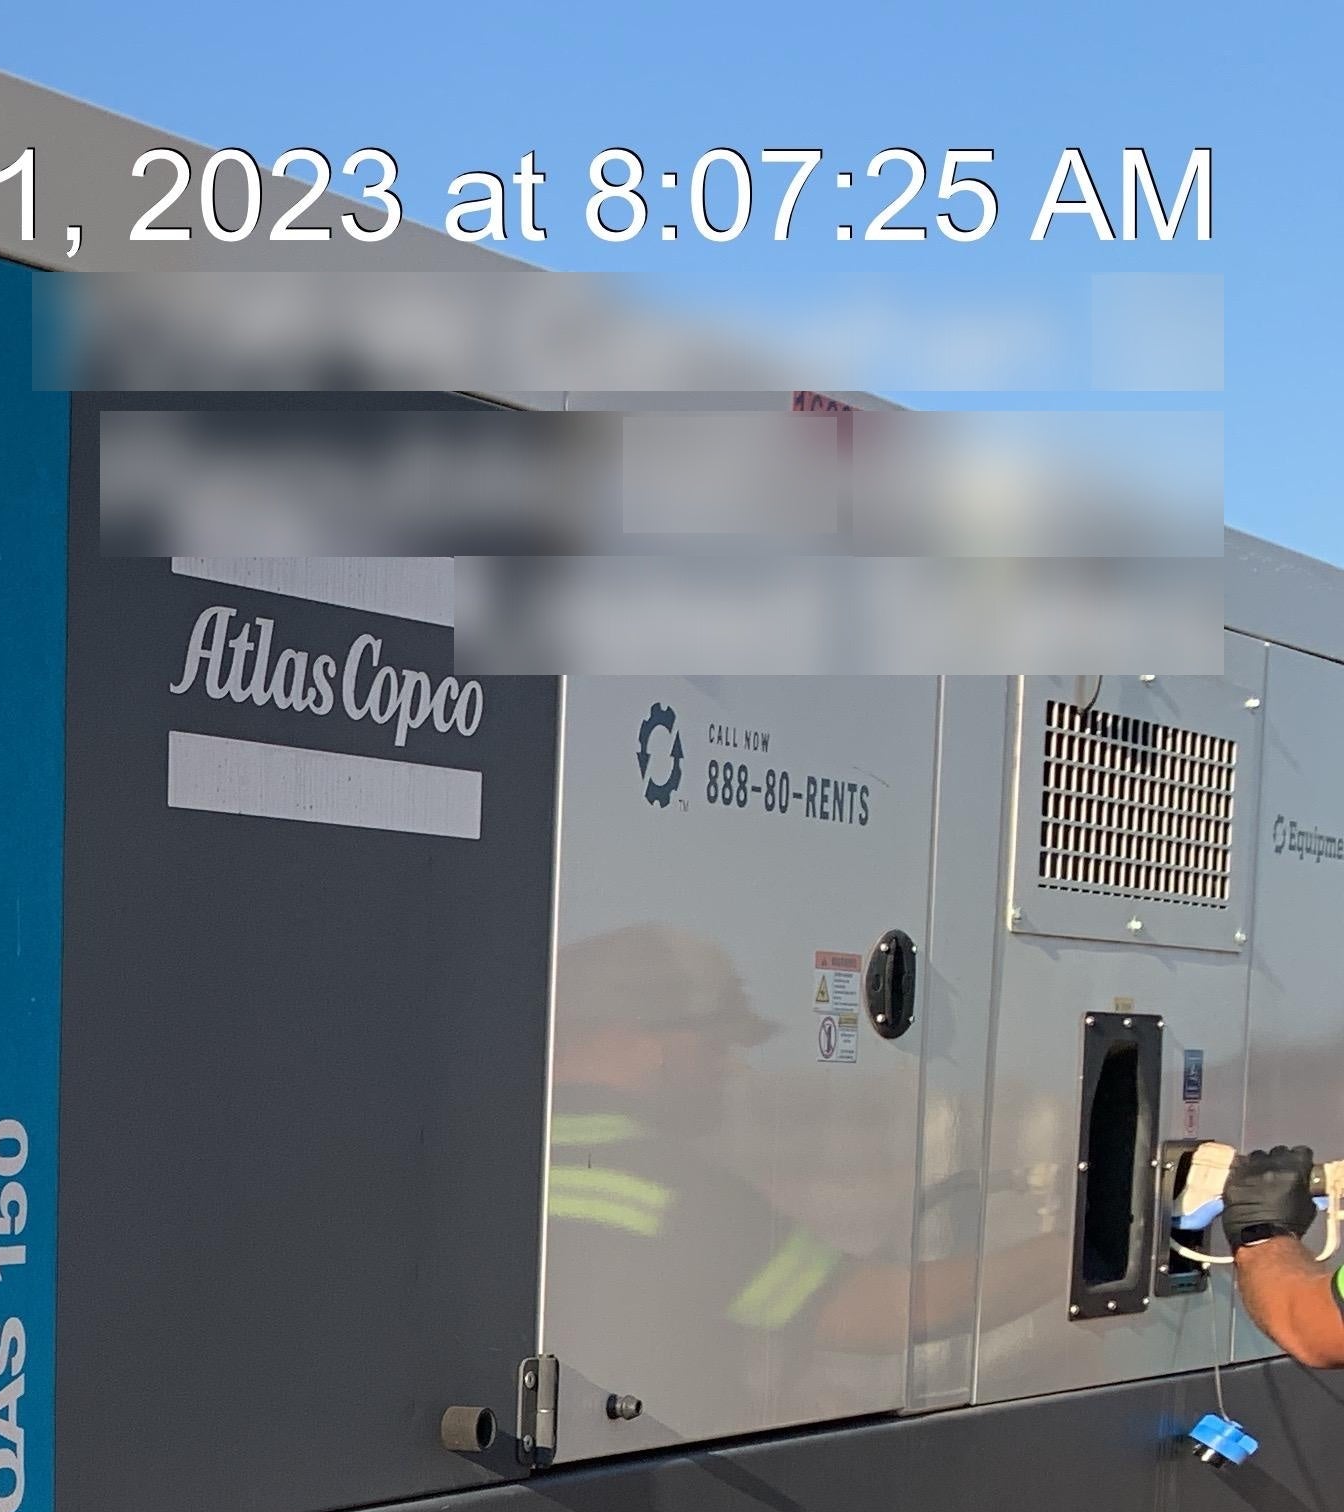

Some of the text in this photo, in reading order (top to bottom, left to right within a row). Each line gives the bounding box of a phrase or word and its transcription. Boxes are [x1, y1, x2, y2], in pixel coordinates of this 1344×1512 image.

[170, 605, 482, 747] Atlas Copco
[709, 723, 770, 753] CALL NOW
[707, 759, 871, 827] 888-80-RENTS
